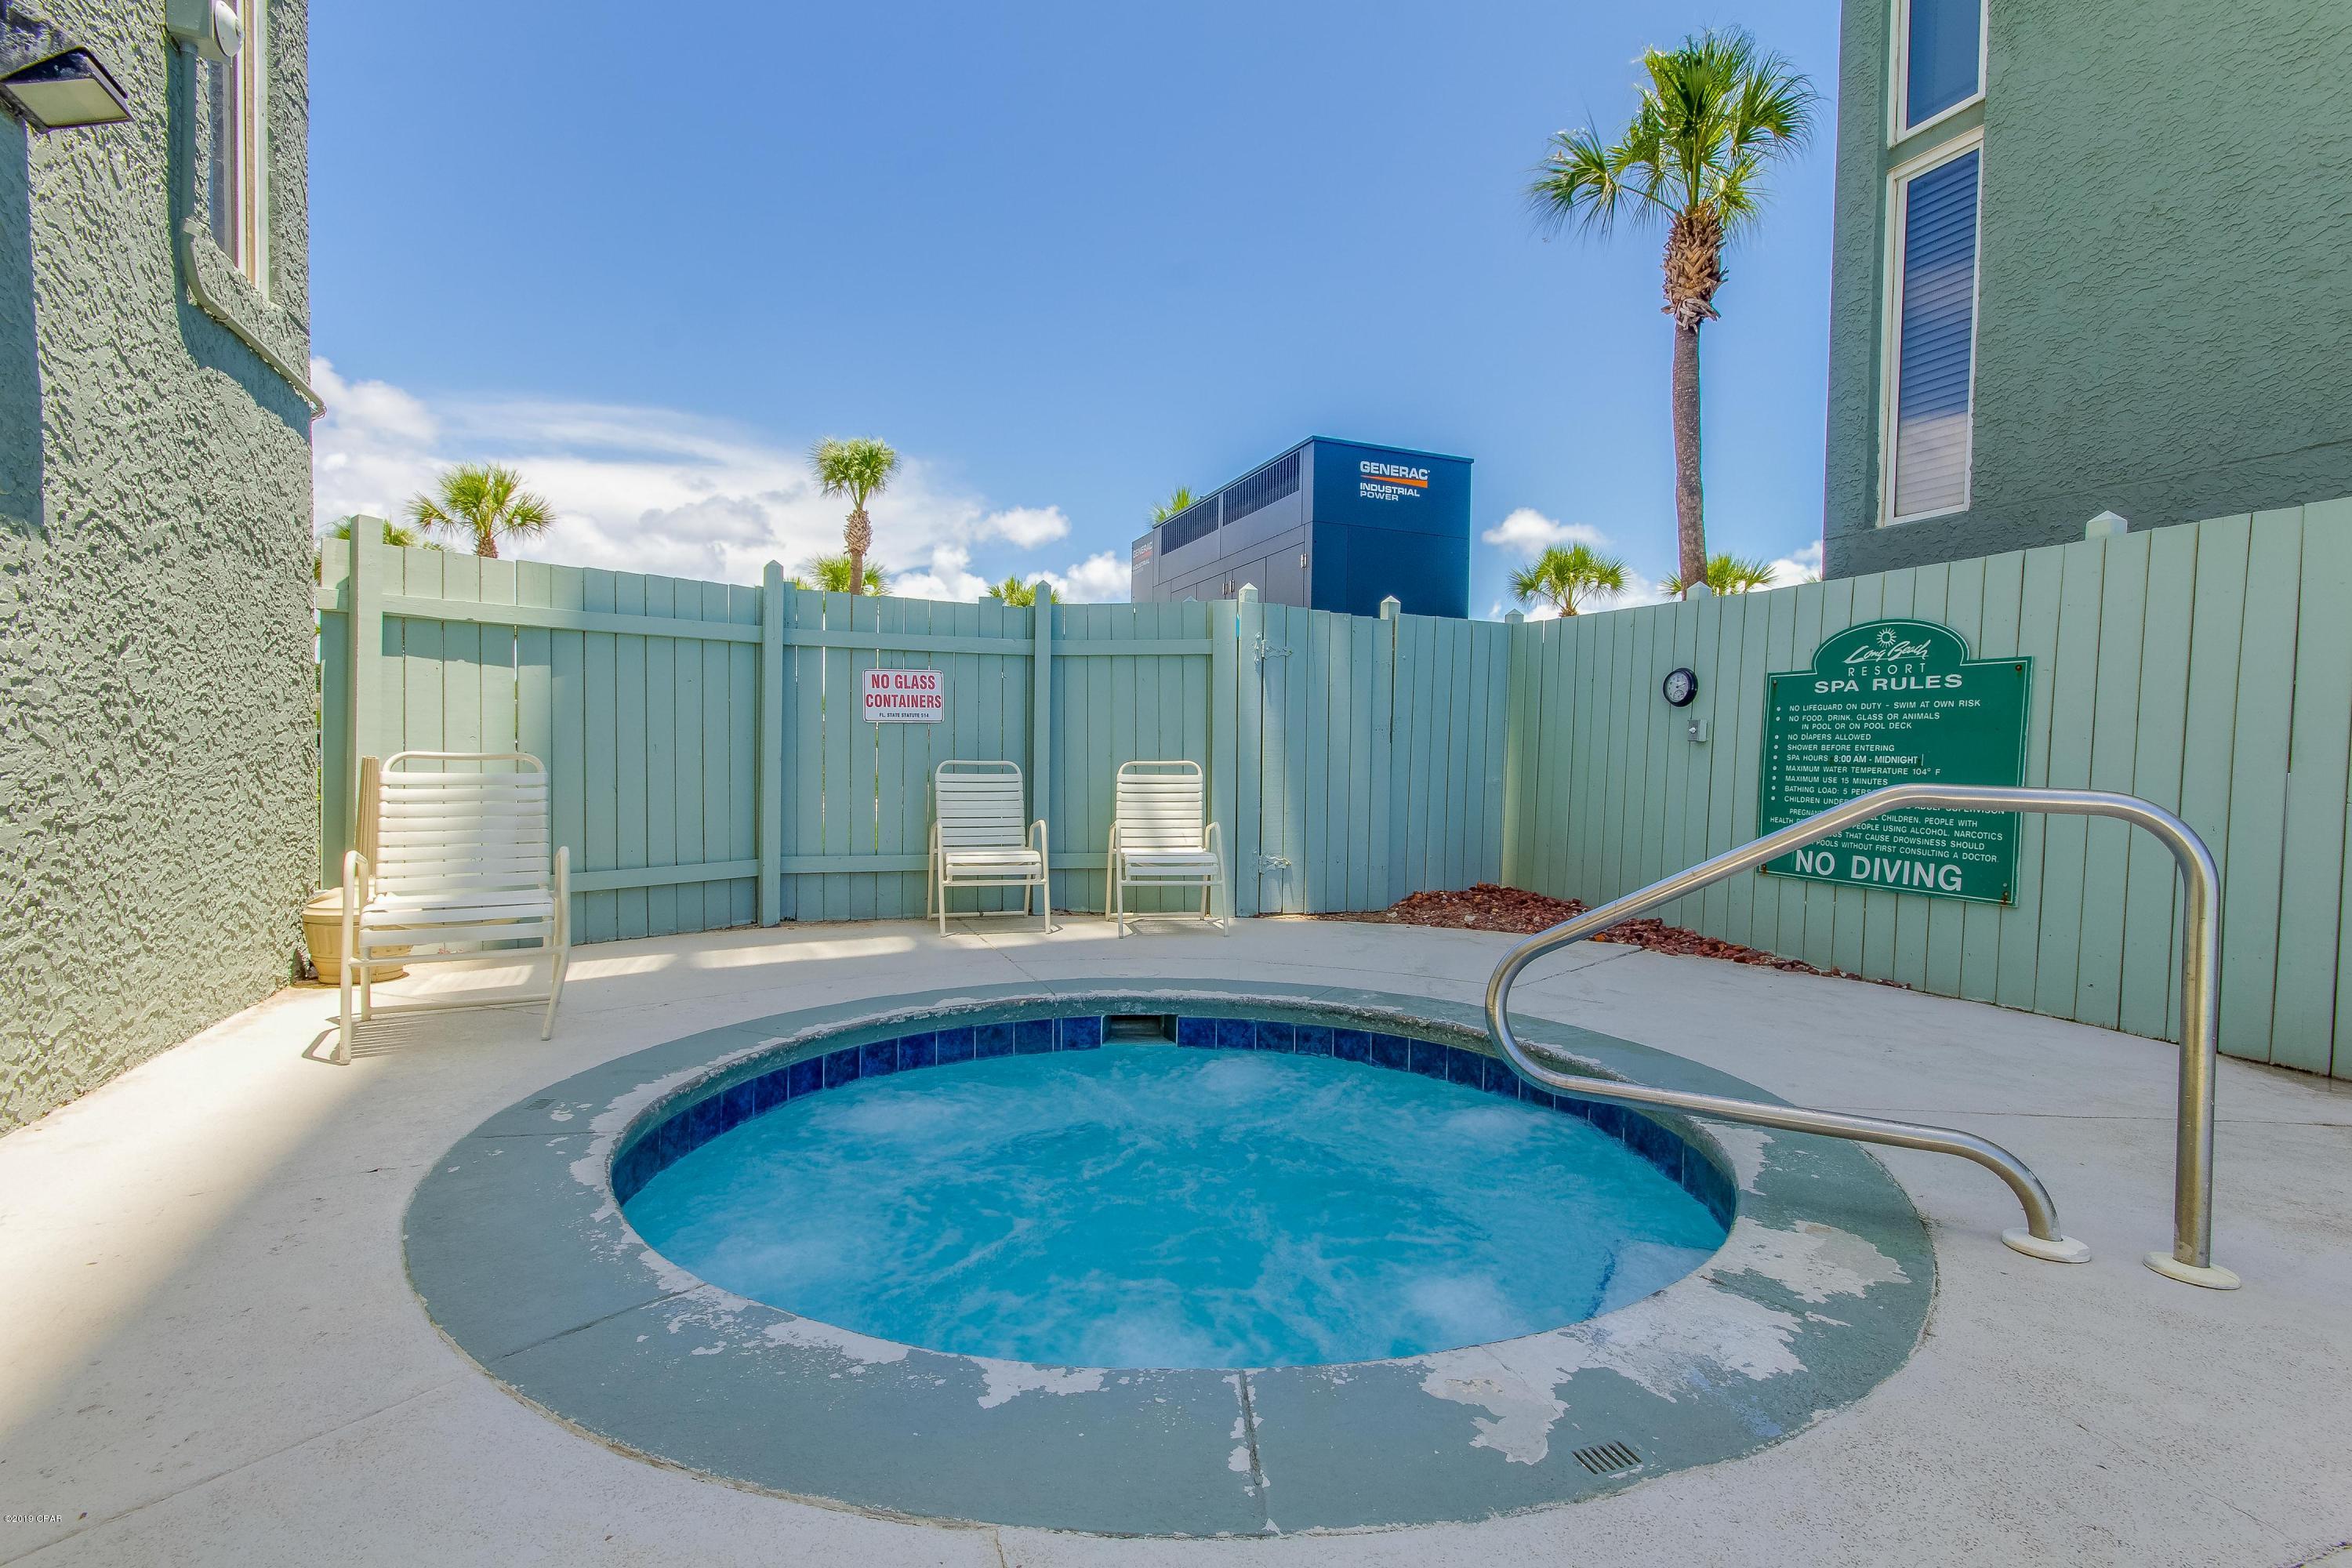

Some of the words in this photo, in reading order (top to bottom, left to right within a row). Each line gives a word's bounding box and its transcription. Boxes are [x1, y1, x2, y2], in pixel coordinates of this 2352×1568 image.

[1360, 460, 1428, 481] GENERAC
[1360, 482, 1421, 497] INDUSTRIAL
[1360, 491, 1399, 501] POWER
[1843, 645, 1886, 664] Long
[1887, 639, 1931, 661] Beach
[1848, 662, 1926, 677] RESORT
[871, 673, 890, 689] NO
[895, 674, 935, 690] GLASS
[1814, 680, 1860, 694] SPA
[1872, 673, 1962, 691] RULES
[866, 694, 942, 709] CONTAINERS
[1874, 755, 1918, 764] MIDNIGHT
[1851, 767, 1908, 775] TEMPERATURE
[1784, 795, 1820, 804] CHILDREN
[1924, 817, 1955, 826] PEOPLE
[1958, 819, 1978, 828] WITH
[1882, 825, 1907, 833] USING
[1954, 830, 2004, 841] NARCOTICS
[1841, 841, 1873, 851] WITHOUT
[1875, 844, 1896, 853] FIRST
[1899, 847, 1951, 858] CONSULTING
[1864, 833, 1890, 842] CAUSE
[1893, 836, 1947, 847] DROWSINESS
[1950, 840, 1986, 851] SHOULD
[1795, 849, 1835, 876] NO
[1850, 855, 1962, 891] DIVING
